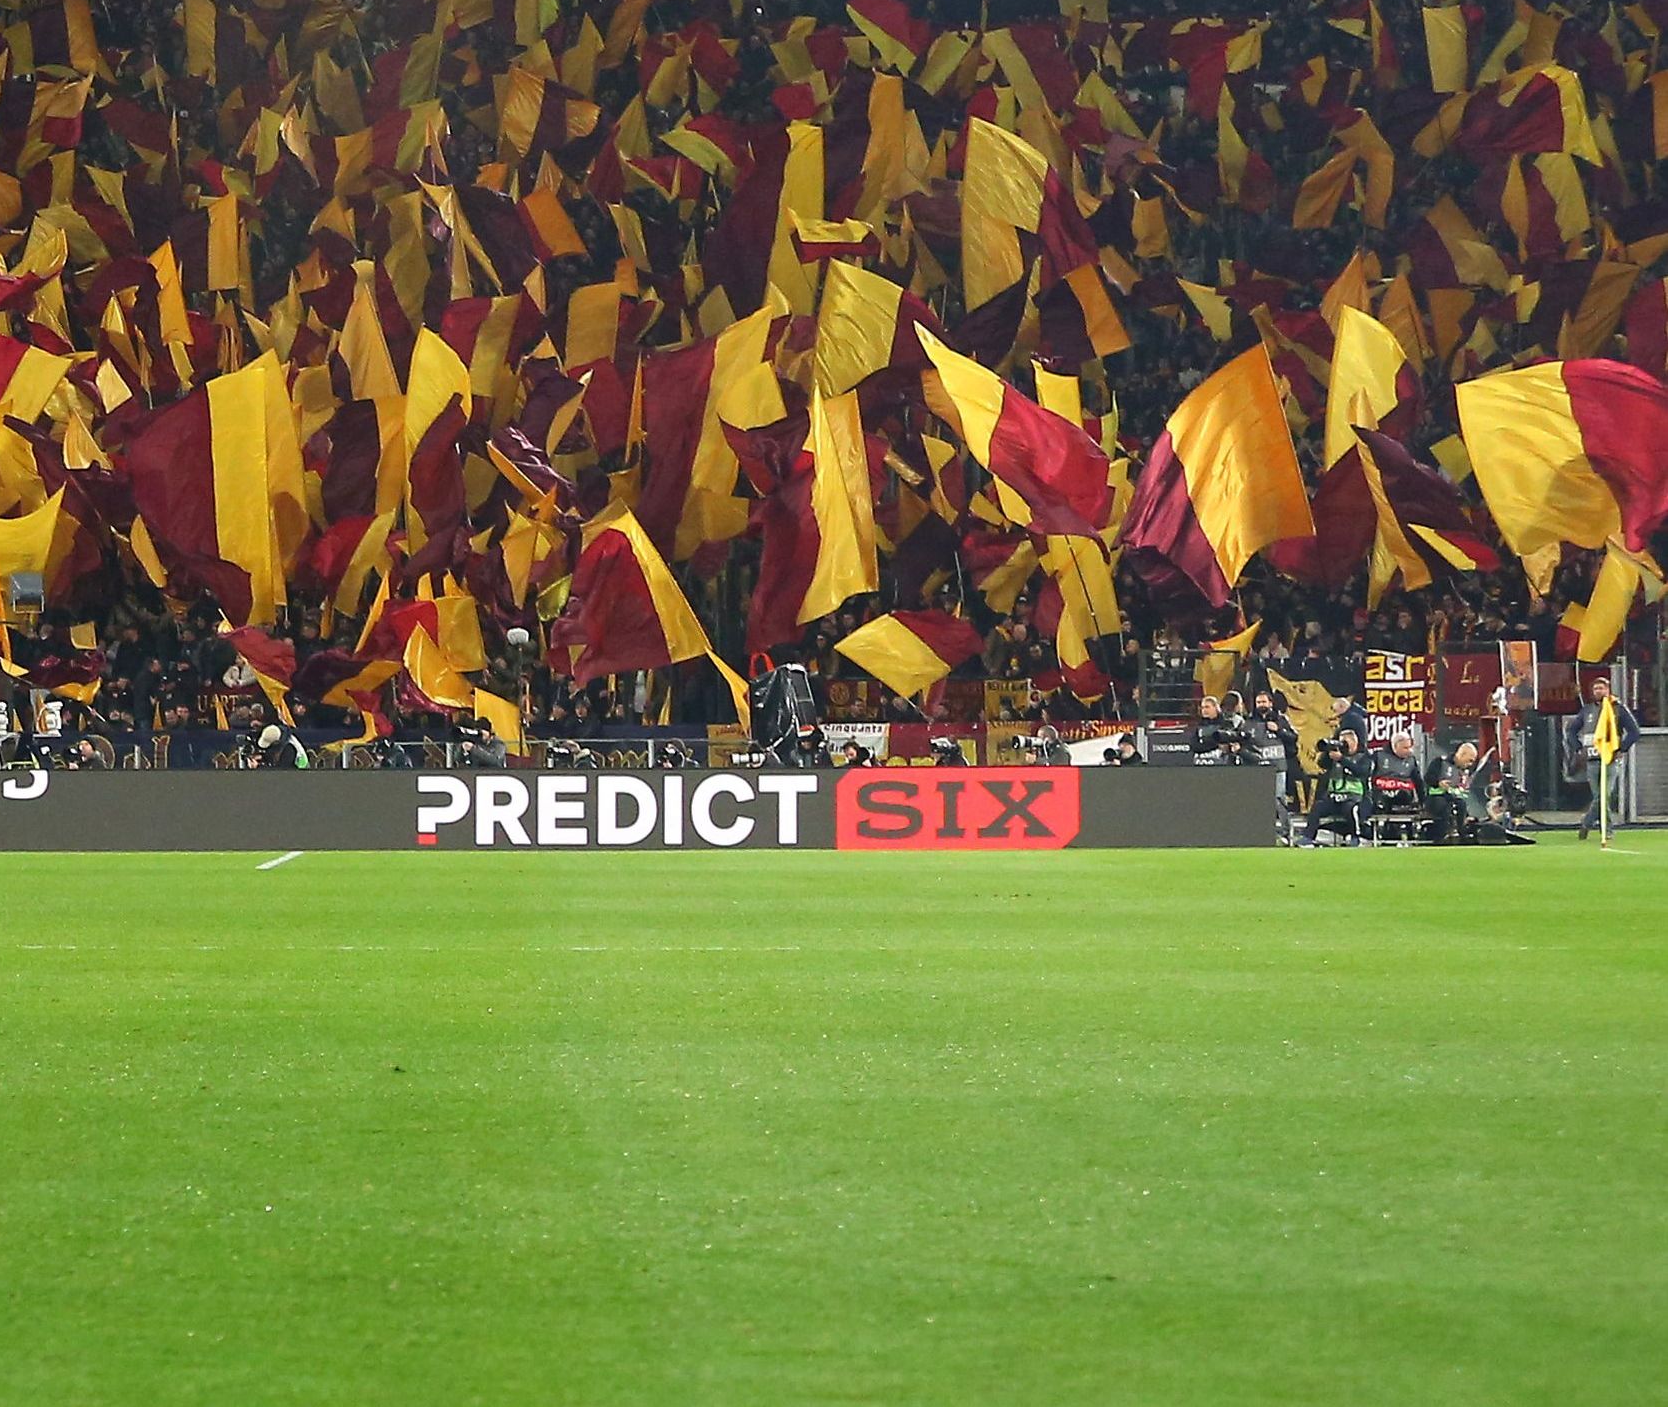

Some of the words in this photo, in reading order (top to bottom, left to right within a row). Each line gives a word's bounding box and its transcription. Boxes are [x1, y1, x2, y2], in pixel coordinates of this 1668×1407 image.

[1365, 655, 1426, 682] asr
[1366, 689, 1424, 713] acca
[416, 774, 818, 847] PREDICT
[856, 779, 1056, 840] SIX
